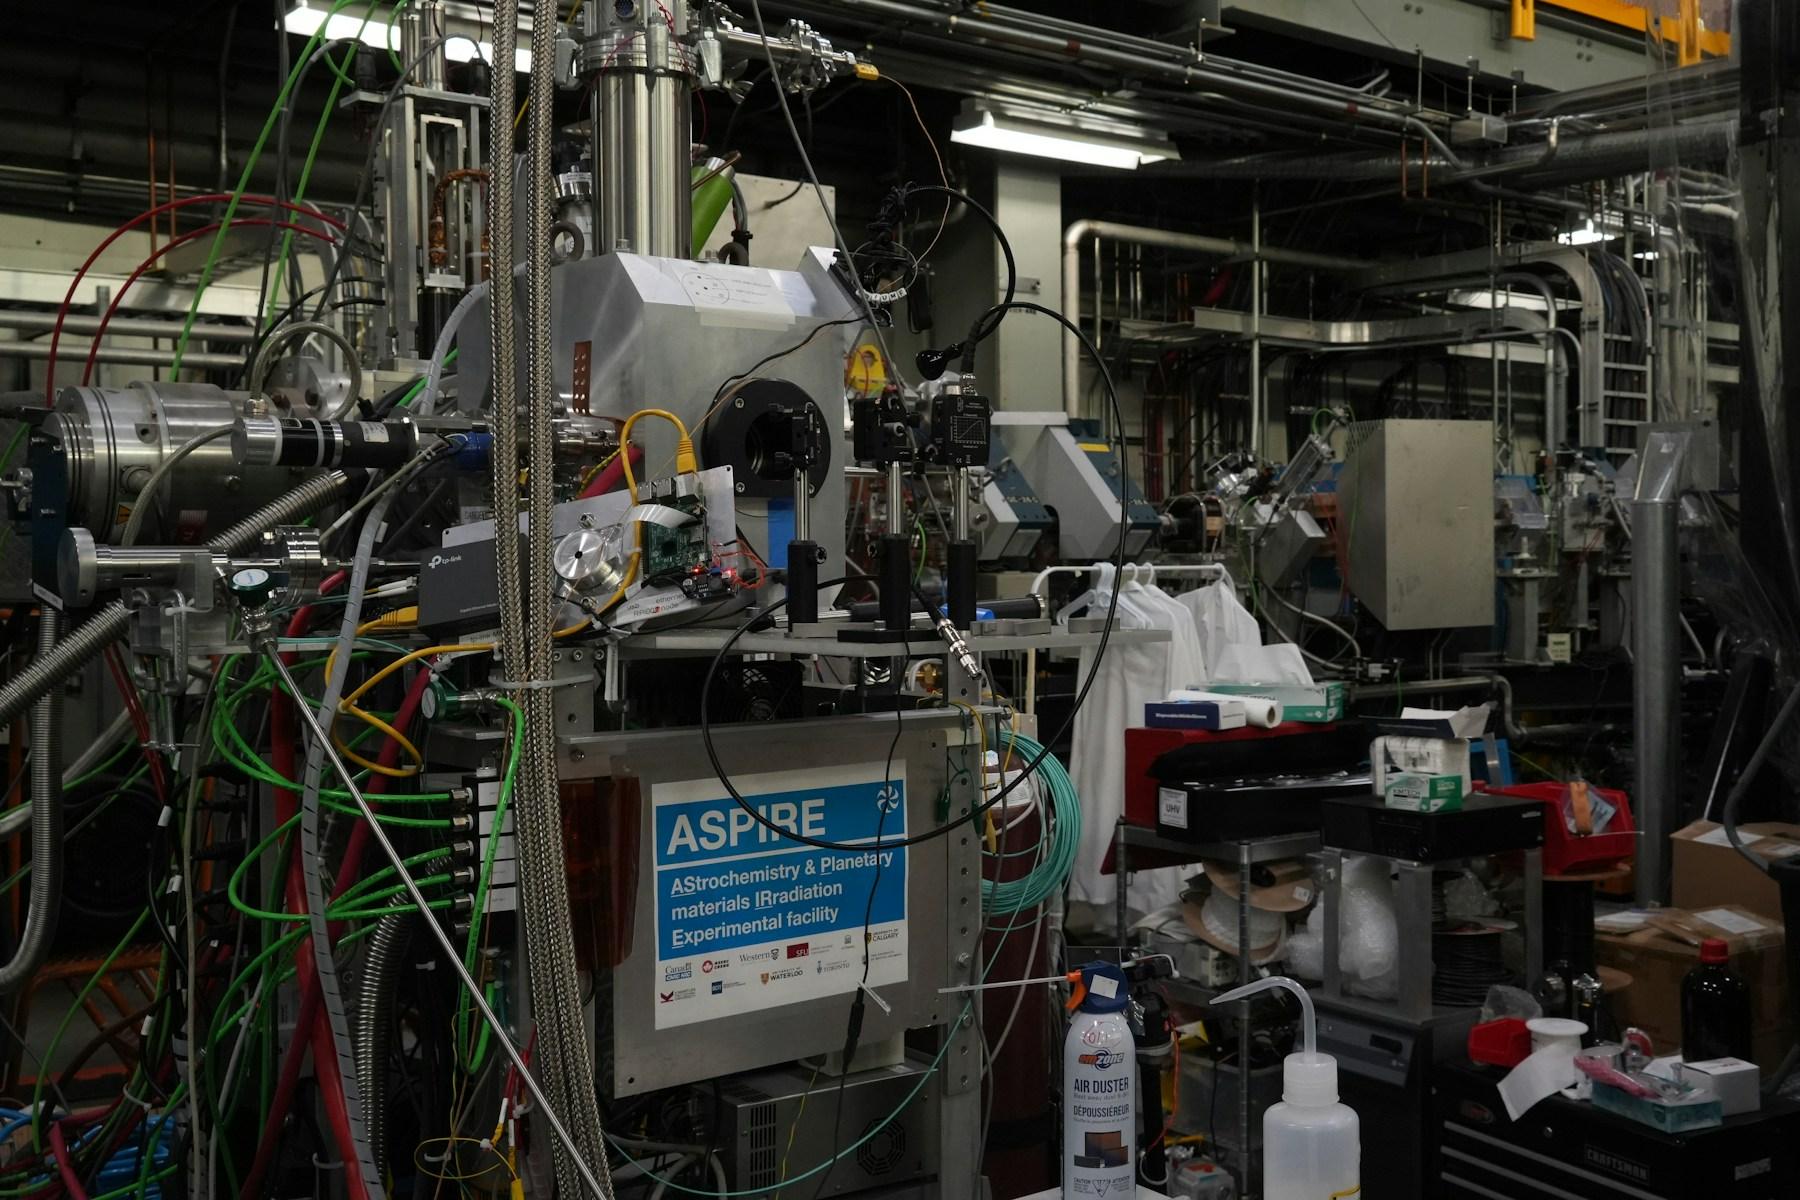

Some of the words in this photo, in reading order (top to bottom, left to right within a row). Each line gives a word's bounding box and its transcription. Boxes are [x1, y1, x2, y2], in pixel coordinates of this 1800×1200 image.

[666, 798, 826, 855] ASPIRE
[671, 864, 800, 897] AStrochemistry
[804, 858, 816, 875] &
[820, 851, 894, 876] Planetary
[671, 894, 750, 920] materials
[755, 882, 843, 910] IRradiation
[672, 914, 783, 949] Experimental
[786, 905, 840, 928] facility
[740, 952, 770, 962] Western
[795, 946, 809, 957] SFU
[770, 970, 804, 981] WATERLOO
[1074, 1078, 1090, 1093] AIR
[1093, 1077, 1129, 1093] DUSTER
